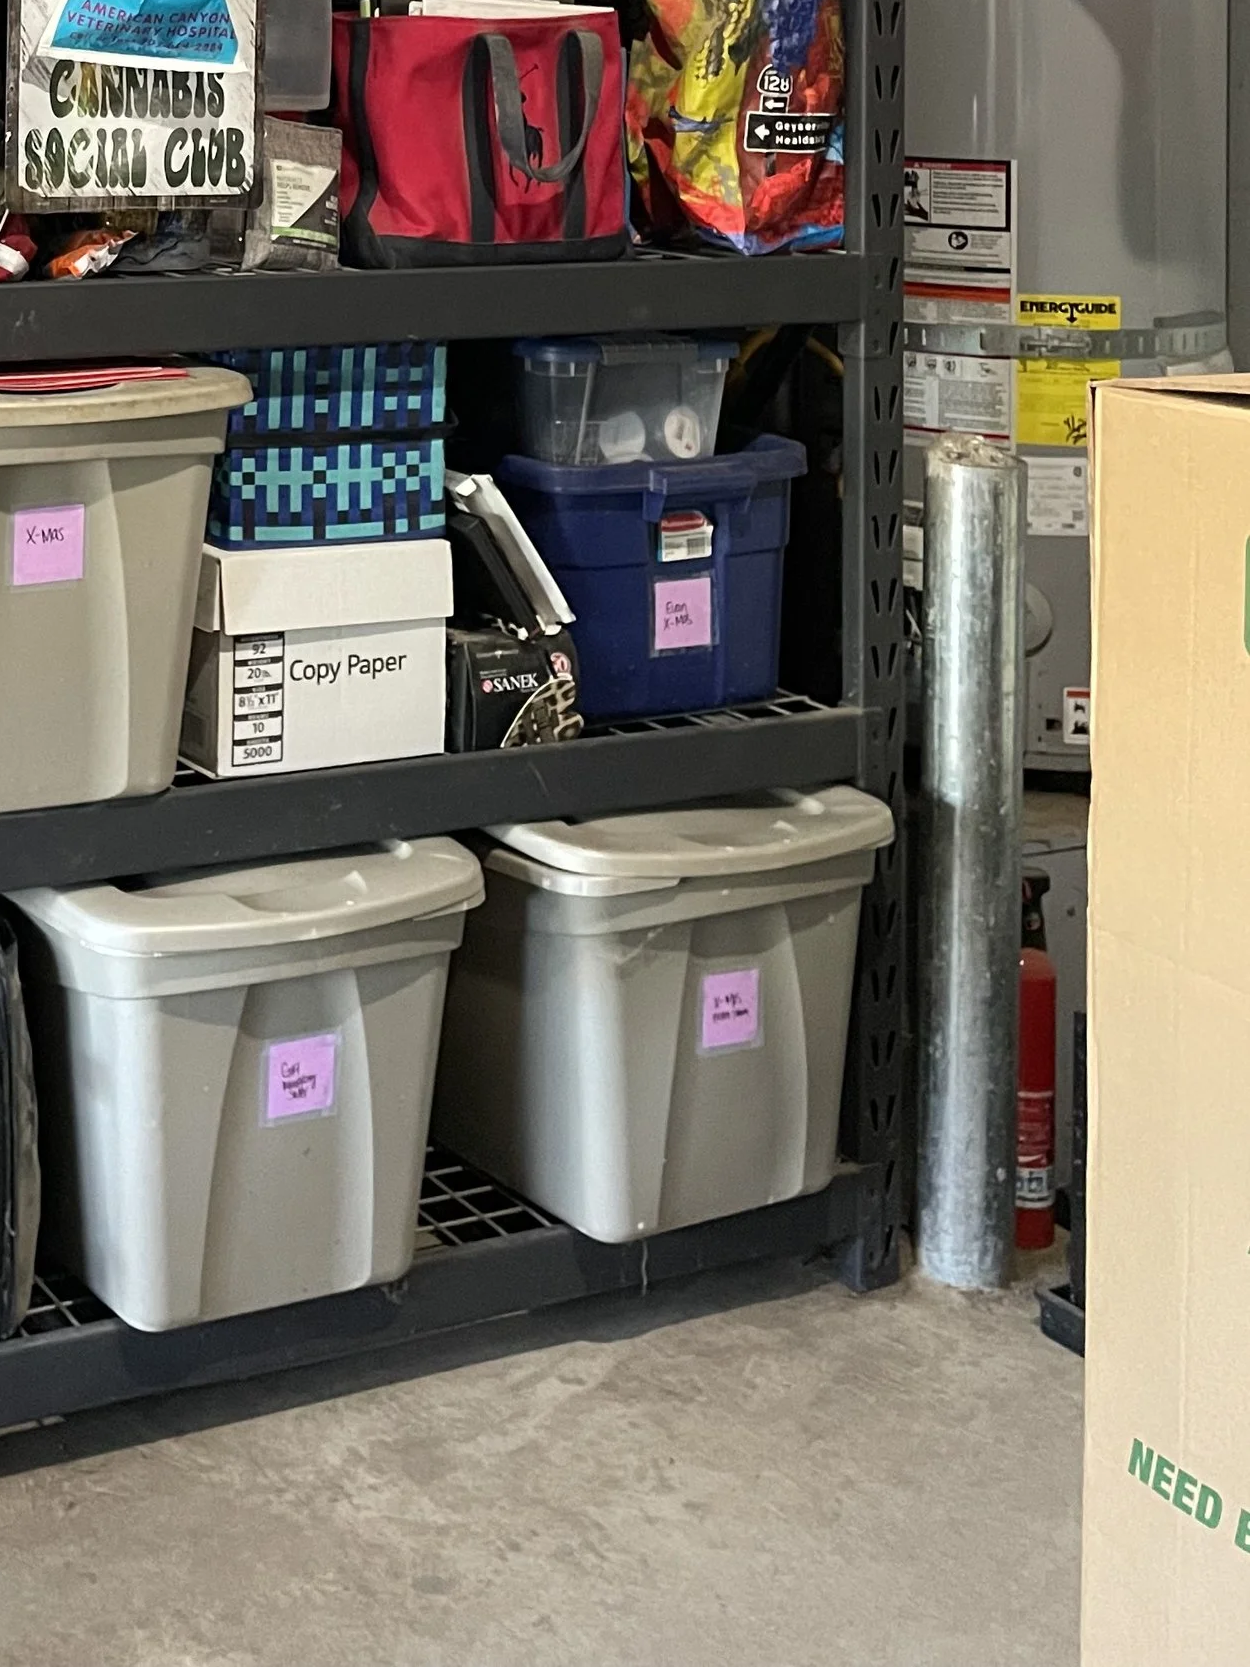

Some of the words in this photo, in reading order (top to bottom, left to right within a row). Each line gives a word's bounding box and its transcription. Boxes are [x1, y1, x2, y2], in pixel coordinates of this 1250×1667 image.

[67, 11, 163, 37] VETERINARY
[166, 26, 236, 41] HOSPITAL
[168, 12, 231, 24] CANYON
[49, 59, 225, 119] CANNABIS
[24, 127, 148, 191] SOCIAL
[164, 127, 247, 191] CLUB
[1019, 300, 1117, 317] ENERGYGUIDE
[251, 642, 267, 655] 92
[289, 659, 341, 685] Copy
[348, 653, 407, 679] Paper
[493, 672, 539, 693] SANEK
[252, 721, 265, 734] 10
[242, 745, 273, 760] 5000
[1127, 1437, 1223, 1530] NEED
